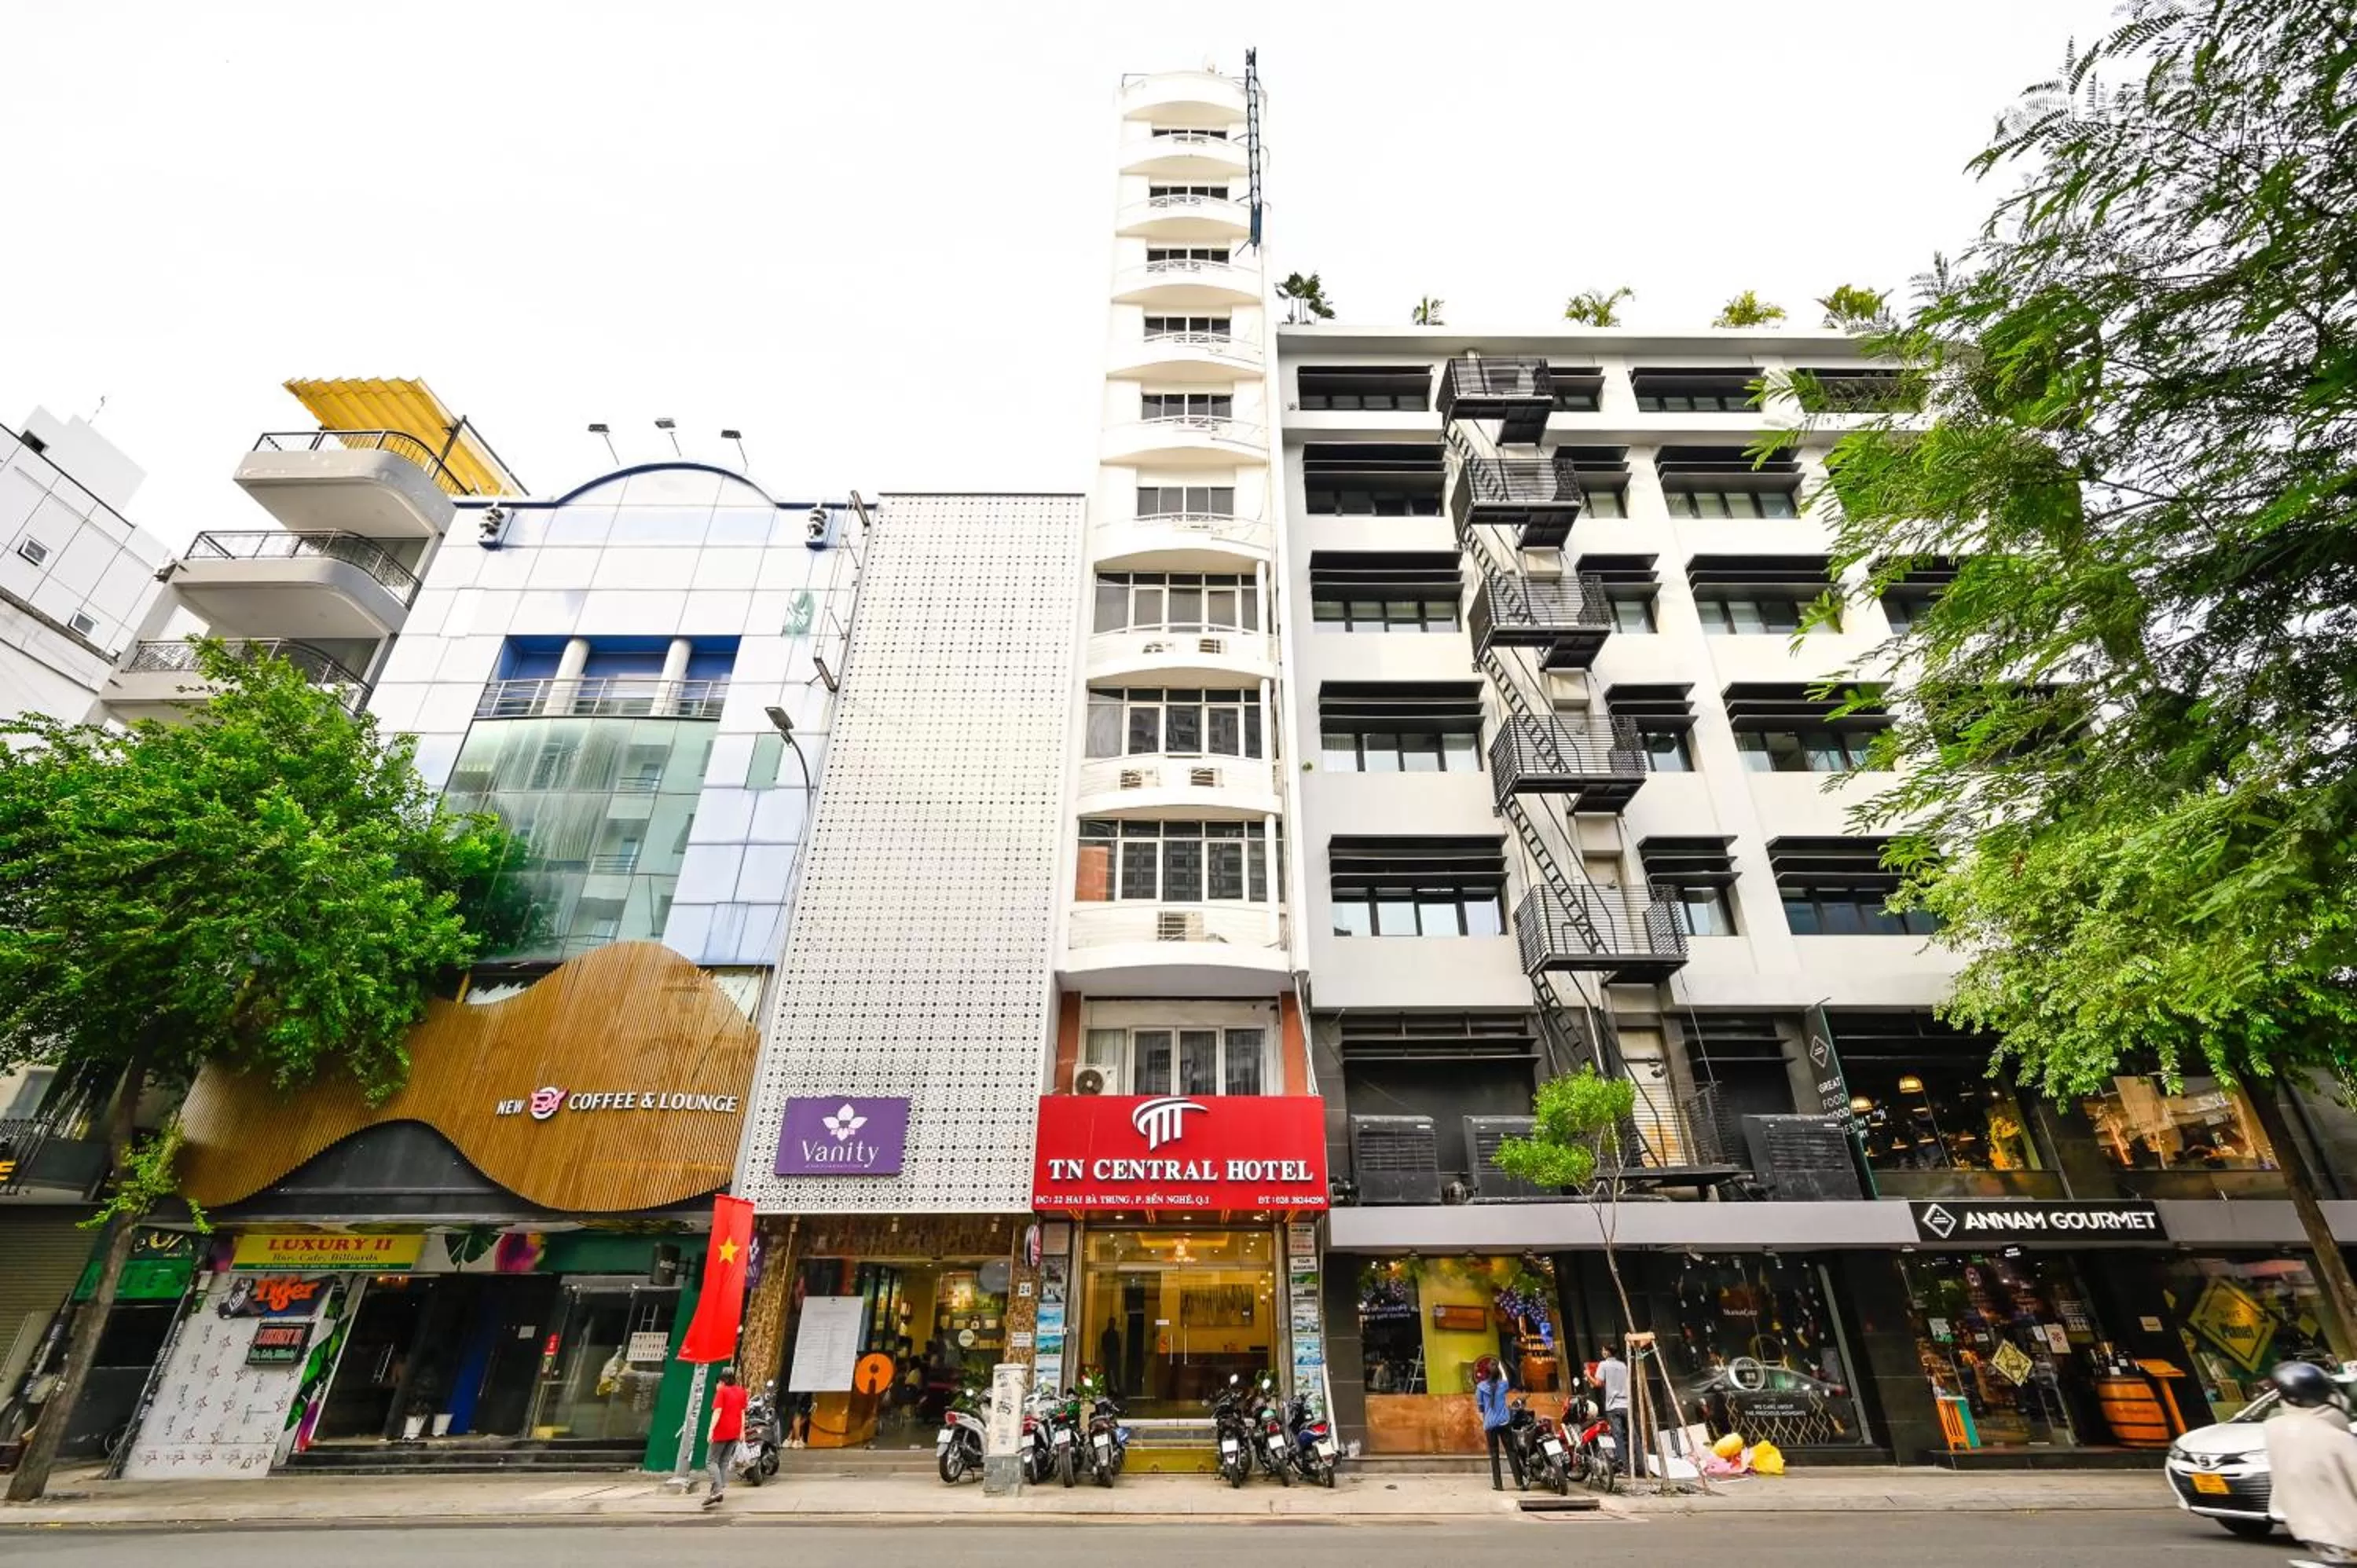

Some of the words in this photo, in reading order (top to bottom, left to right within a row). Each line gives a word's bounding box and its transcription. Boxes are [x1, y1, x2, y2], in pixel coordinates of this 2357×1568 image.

[497, 1100, 525, 1115] NEW
[569, 1094, 636, 1110] COFFEE
[640, 1093, 656, 1109] &
[660, 1093, 737, 1112] LOUNGE
[1822, 1093, 1846, 1109] FOOD
[802, 1140, 879, 1168] Vanity
[1048, 1159, 1084, 1180] TN
[1093, 1159, 1219, 1181] CENTRAL
[1226, 1160, 1314, 1181] HOTEL
[1085, 1193, 1097, 1203] BÀ
[1965, 1211, 2047, 1229] ANNAM
[2050, 1211, 2156, 1229] GOURMET
[267, 1238, 368, 1251] LUXURY
[374, 1238, 393, 1251] II
[256, 1277, 320, 1310] Tiger
